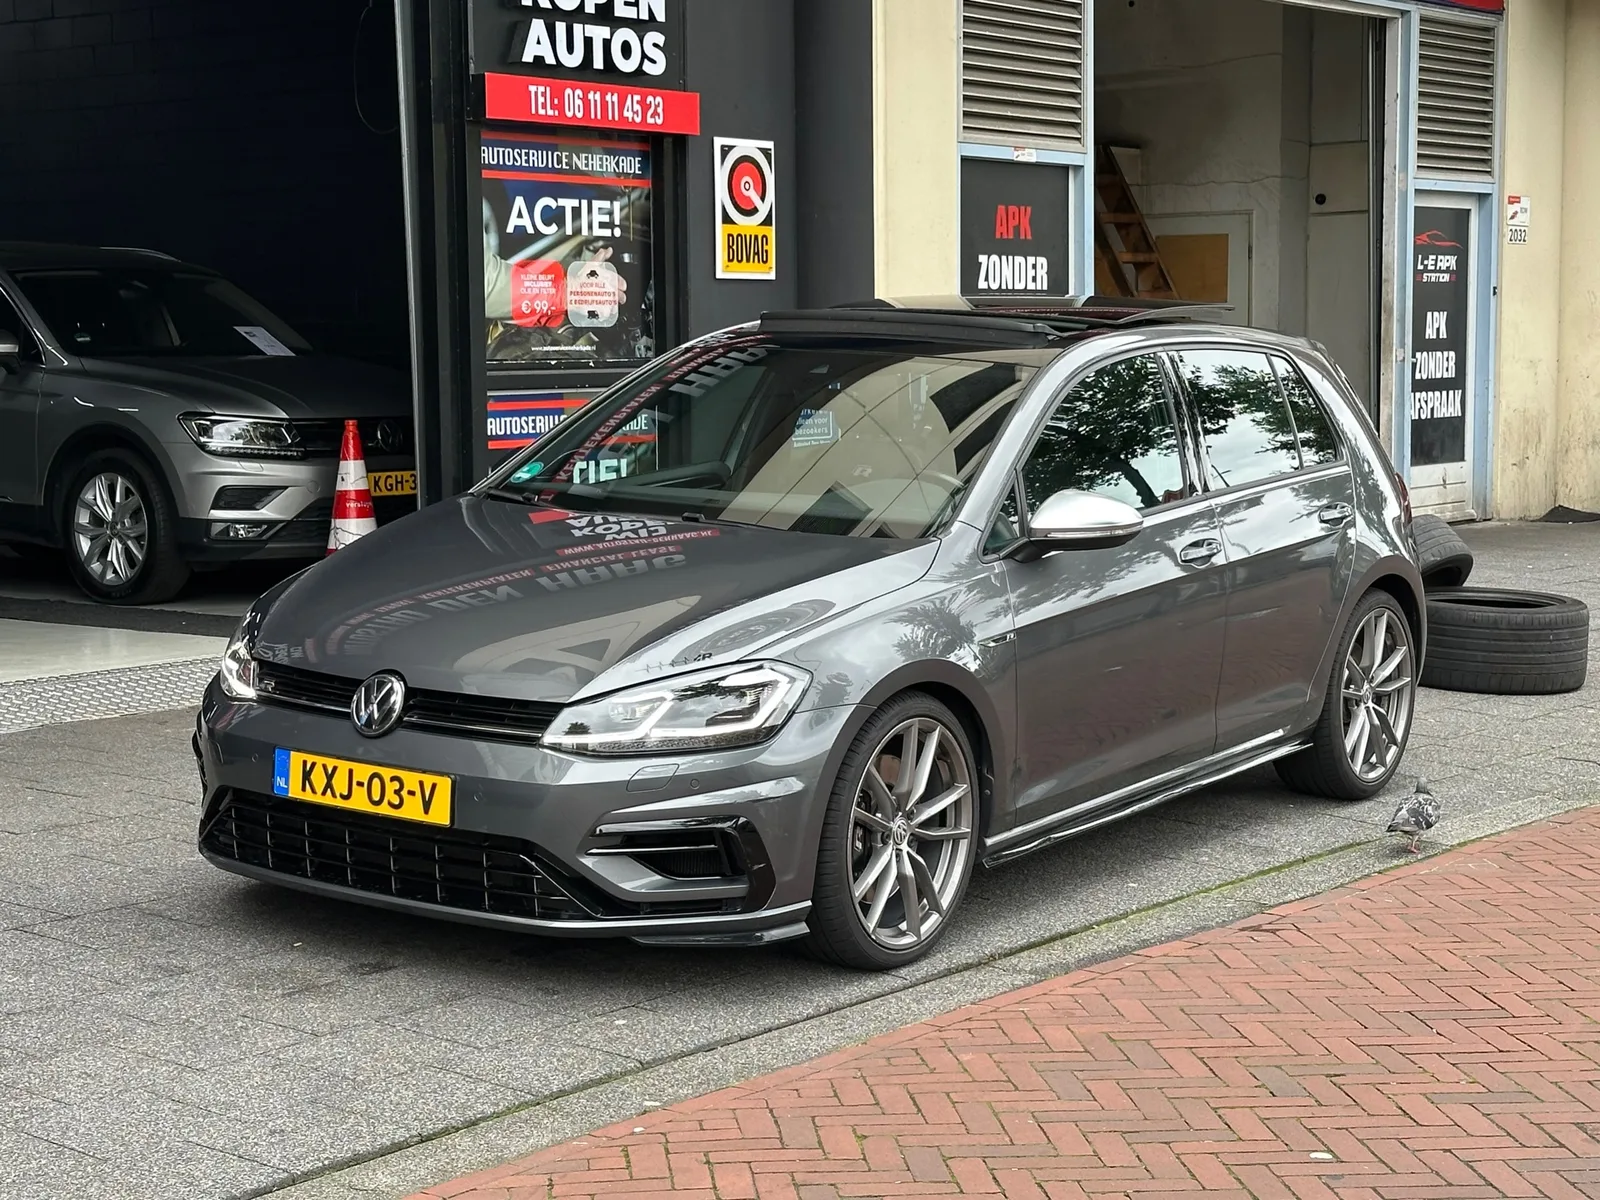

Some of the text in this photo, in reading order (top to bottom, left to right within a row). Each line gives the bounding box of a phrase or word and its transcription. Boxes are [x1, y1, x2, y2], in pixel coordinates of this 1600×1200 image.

[521, 18, 667, 76] AUTOS
[528, 84, 664, 125] TEL: 06 11 11 45 23
[481, 146, 642, 174] AUTOSERVICE NEHERKADE
[506, 195, 622, 238] ACTIE!
[995, 204, 1032, 240] APK
[727, 233, 769, 264] BOVAG
[1509, 229, 1527, 242] 2032
[977, 254, 1048, 290] ZONDER
[1417, 255, 1457, 270] L-E APK
[1422, 273, 1450, 282] STATION
[1425, 311, 1447, 339] APK
[1414, 351, 1456, 380] ZONDER
[276, 759, 437, 816] NL KXJ-03-V
